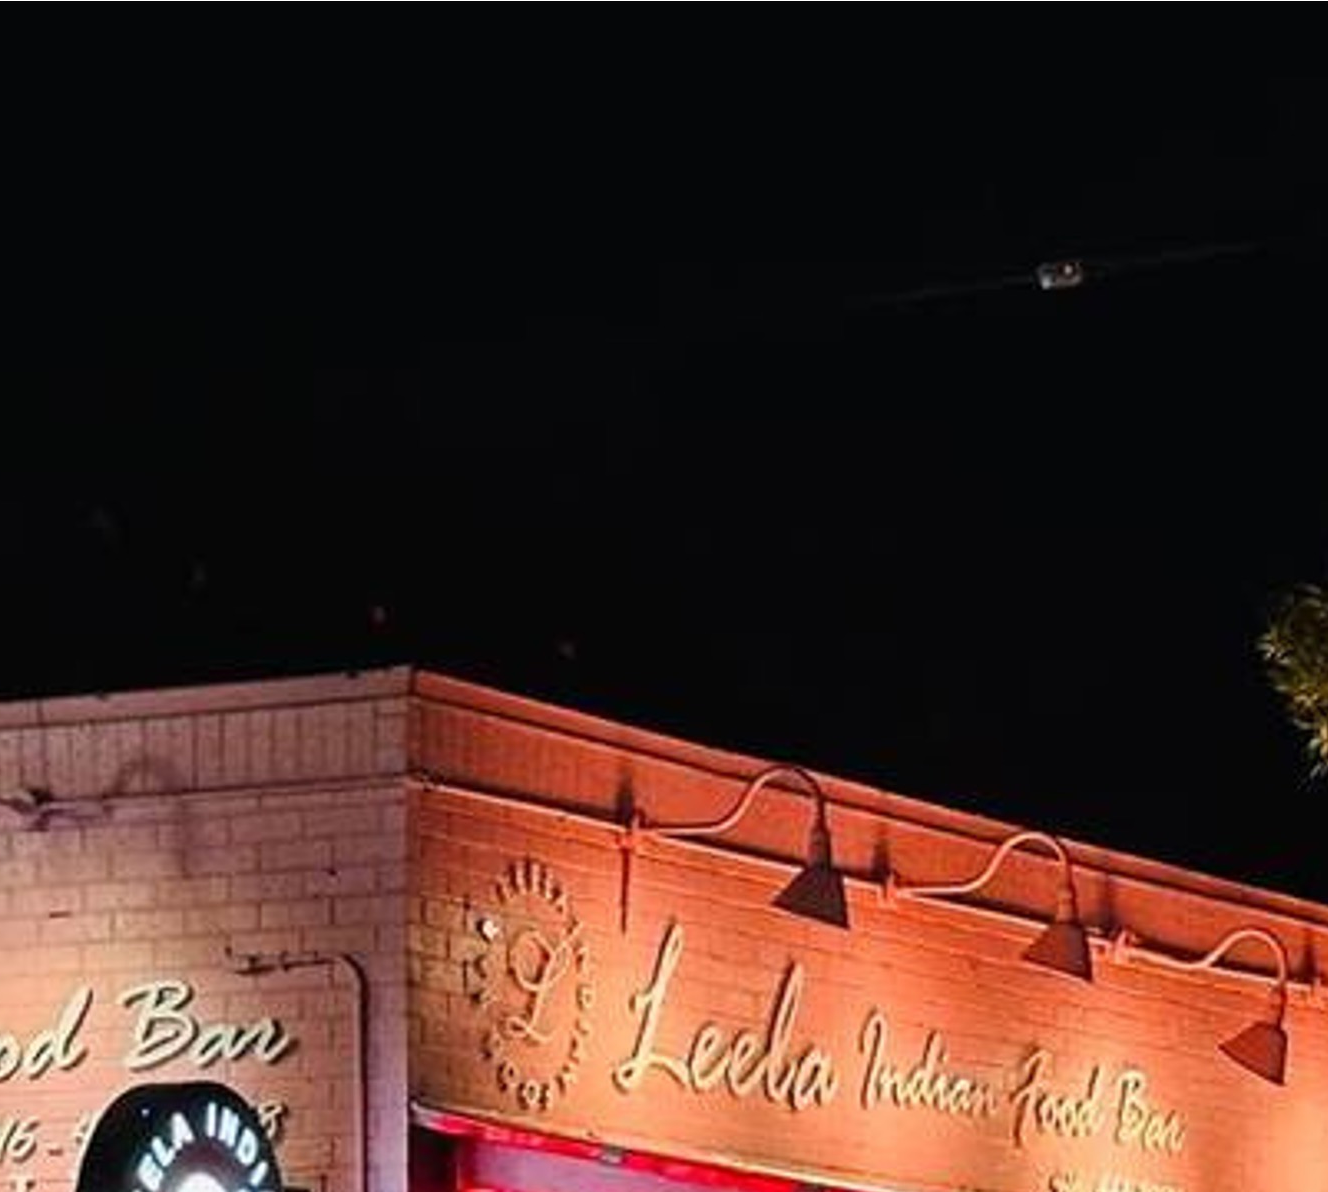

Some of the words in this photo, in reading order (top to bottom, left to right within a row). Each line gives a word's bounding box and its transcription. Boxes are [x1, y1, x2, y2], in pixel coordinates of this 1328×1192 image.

[123, 979, 298, 1073] Bar
[611, 915, 838, 1114] Leela
[858, 1006, 998, 1118] Indian
[1008, 1043, 1107, 1152] Food
[1113, 1066, 1187, 1156] Bar
